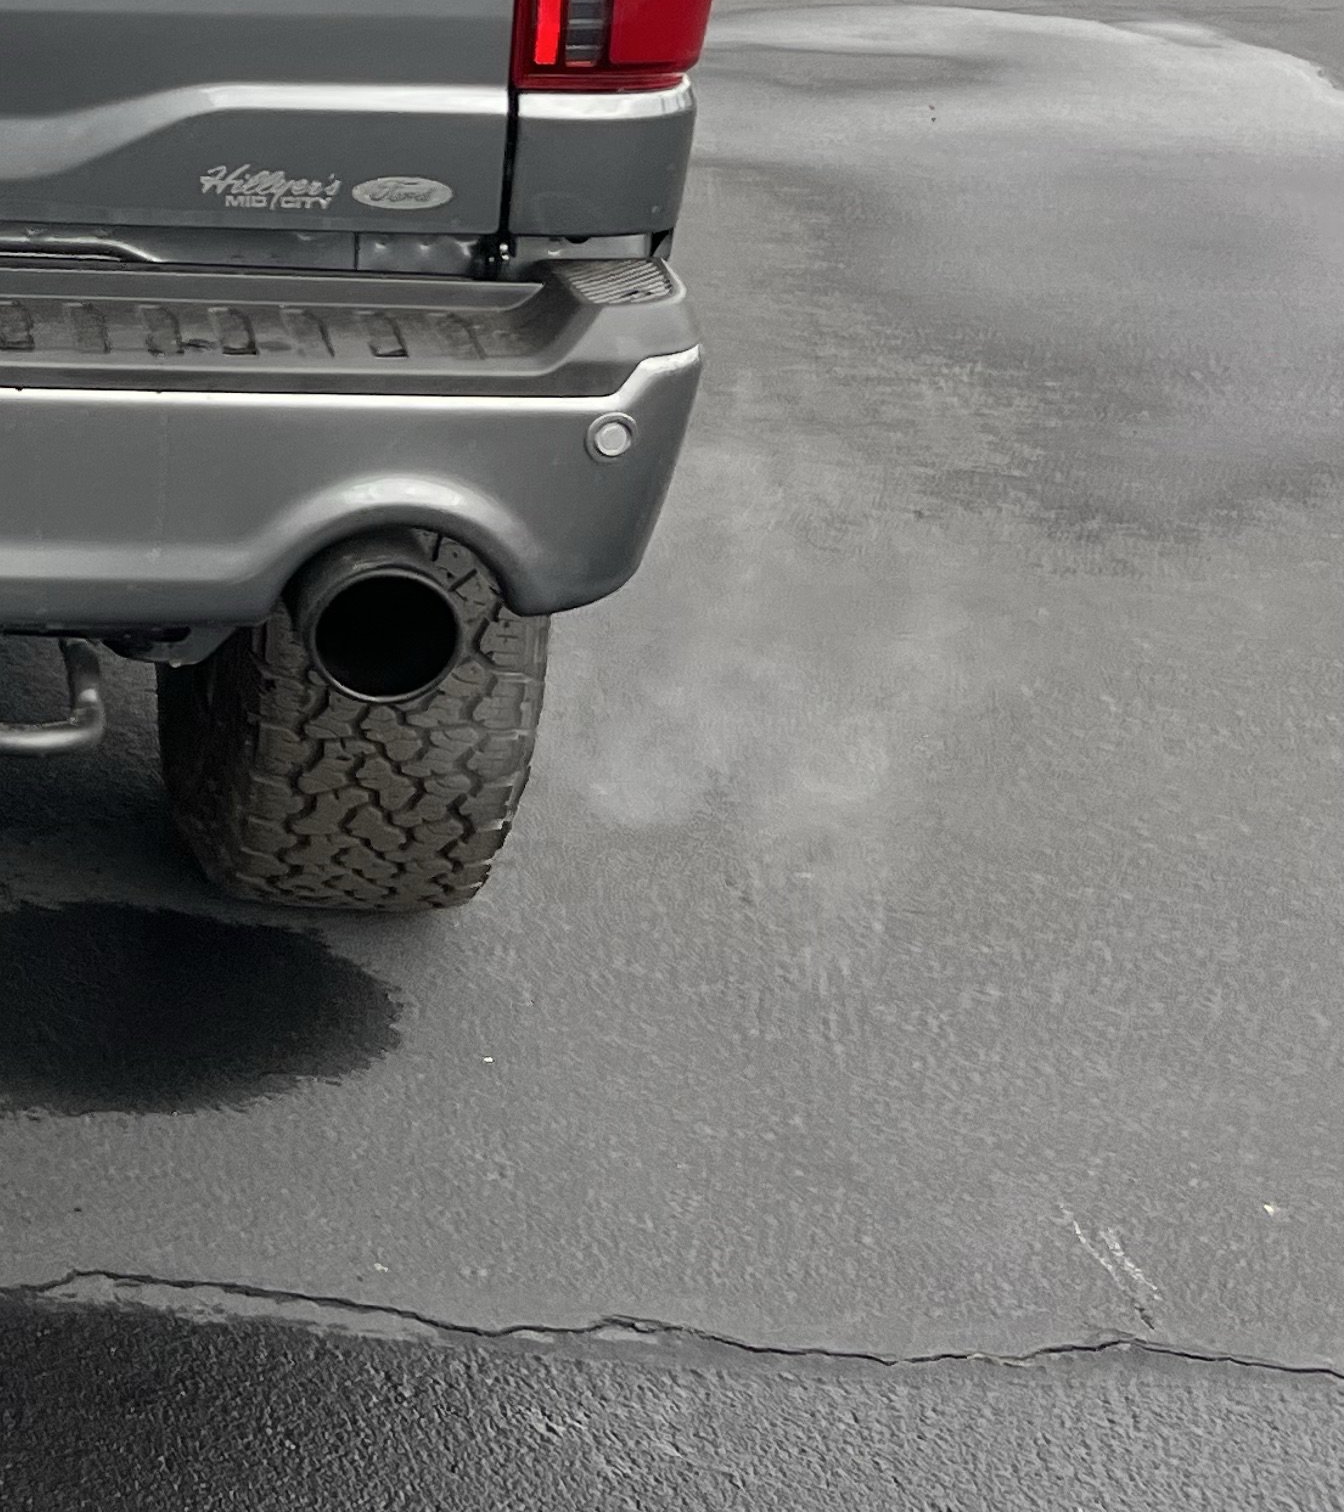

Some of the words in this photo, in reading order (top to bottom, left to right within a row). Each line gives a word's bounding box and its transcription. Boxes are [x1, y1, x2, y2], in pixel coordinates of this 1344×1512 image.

[200, 164, 341, 211] Hillyer's
[225, 195, 268, 208] MID
[281, 195, 333, 210] CITY
